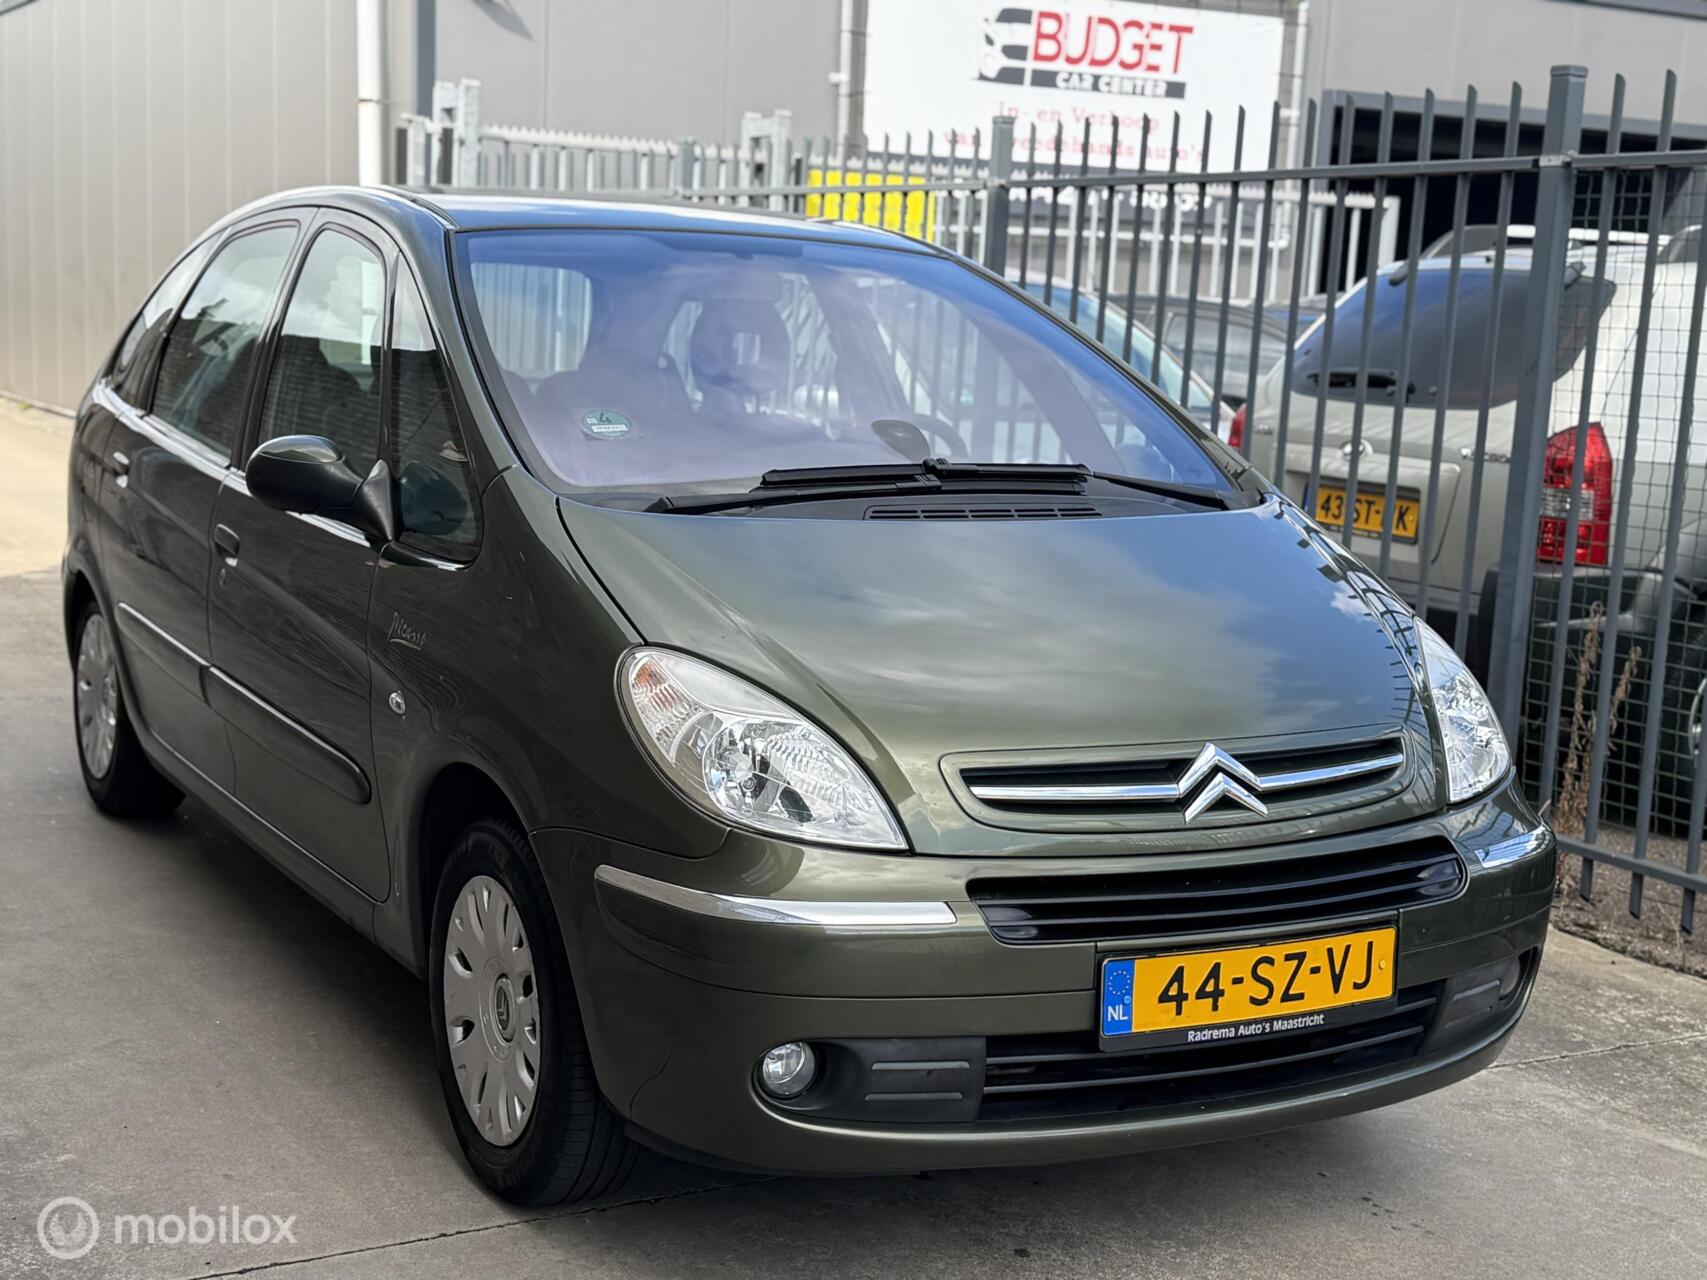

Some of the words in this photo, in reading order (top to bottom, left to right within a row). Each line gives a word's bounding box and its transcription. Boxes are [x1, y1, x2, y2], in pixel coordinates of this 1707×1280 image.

[1033, 11, 1194, 75] BUDGET
[1056, 71, 1094, 91] CAR
[1098, 75, 1168, 98] CENTER
[1037, 109, 1061, 122] en
[1072, 106, 1160, 136] Veroop
[1157, 940, 1375, 1017] 44-SZ-VJ
[1107, 1005, 1129, 1022] NL
[1187, 1026, 1236, 1043] Radrema
[1237, 1021, 1271, 1037] Auto's
[1272, 1012, 1325, 1031] Maastricht
